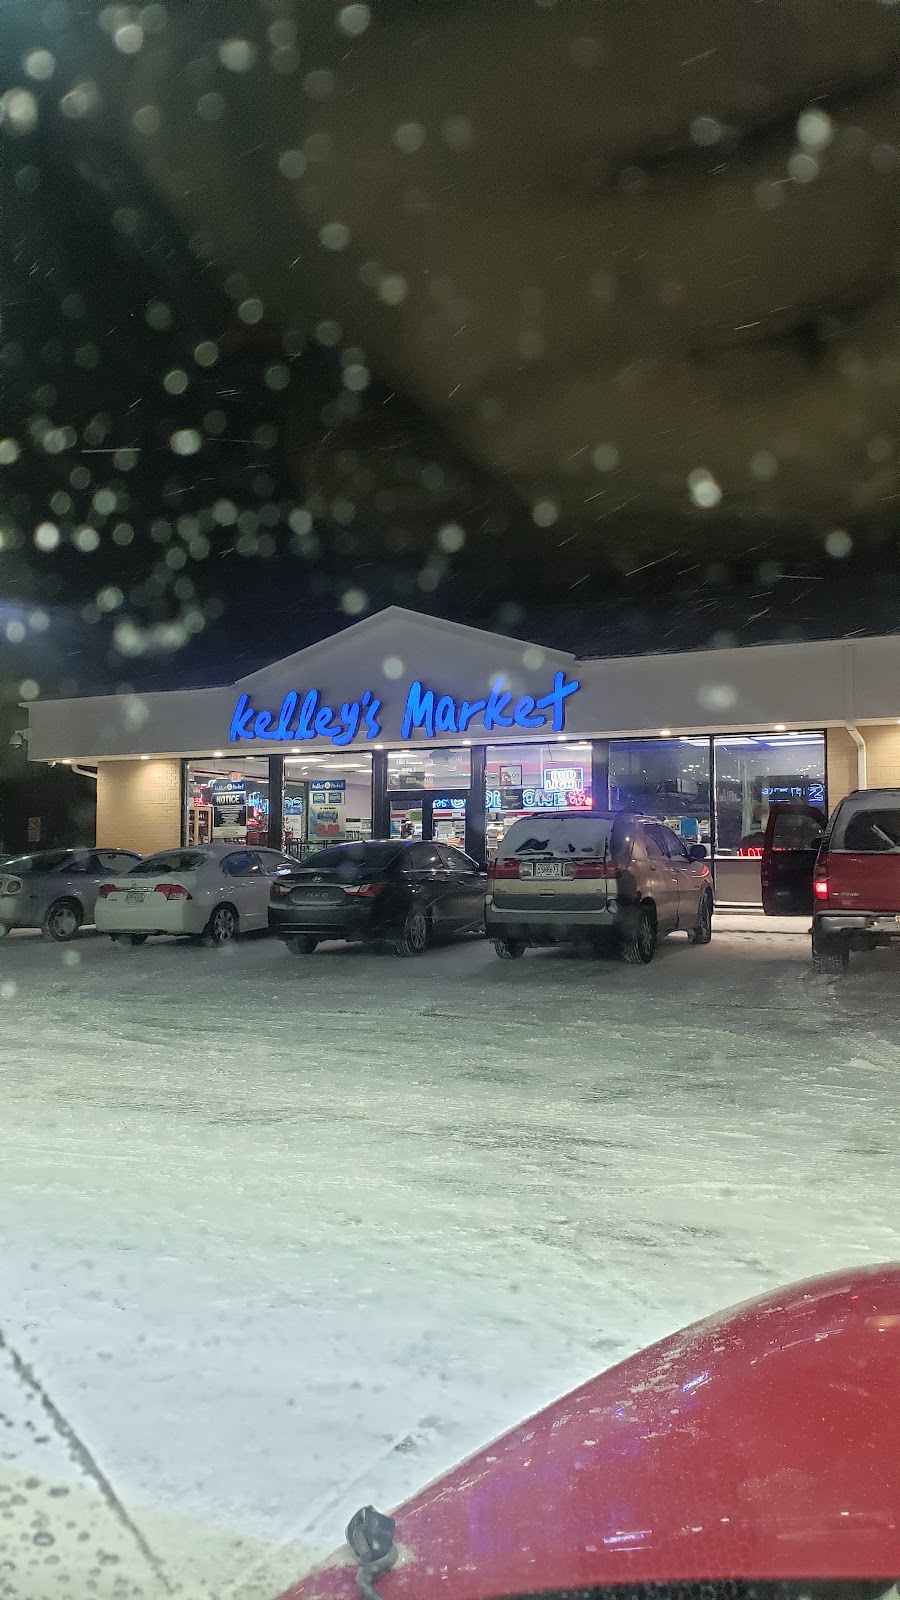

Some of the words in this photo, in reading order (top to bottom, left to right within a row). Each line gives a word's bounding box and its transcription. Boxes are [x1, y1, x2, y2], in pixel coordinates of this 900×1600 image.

[401, 671, 580, 740] Market
[551, 770, 577, 780] BUD
[546, 780, 581, 790] LIGHT
[216, 795, 240, 804] NOTICE
